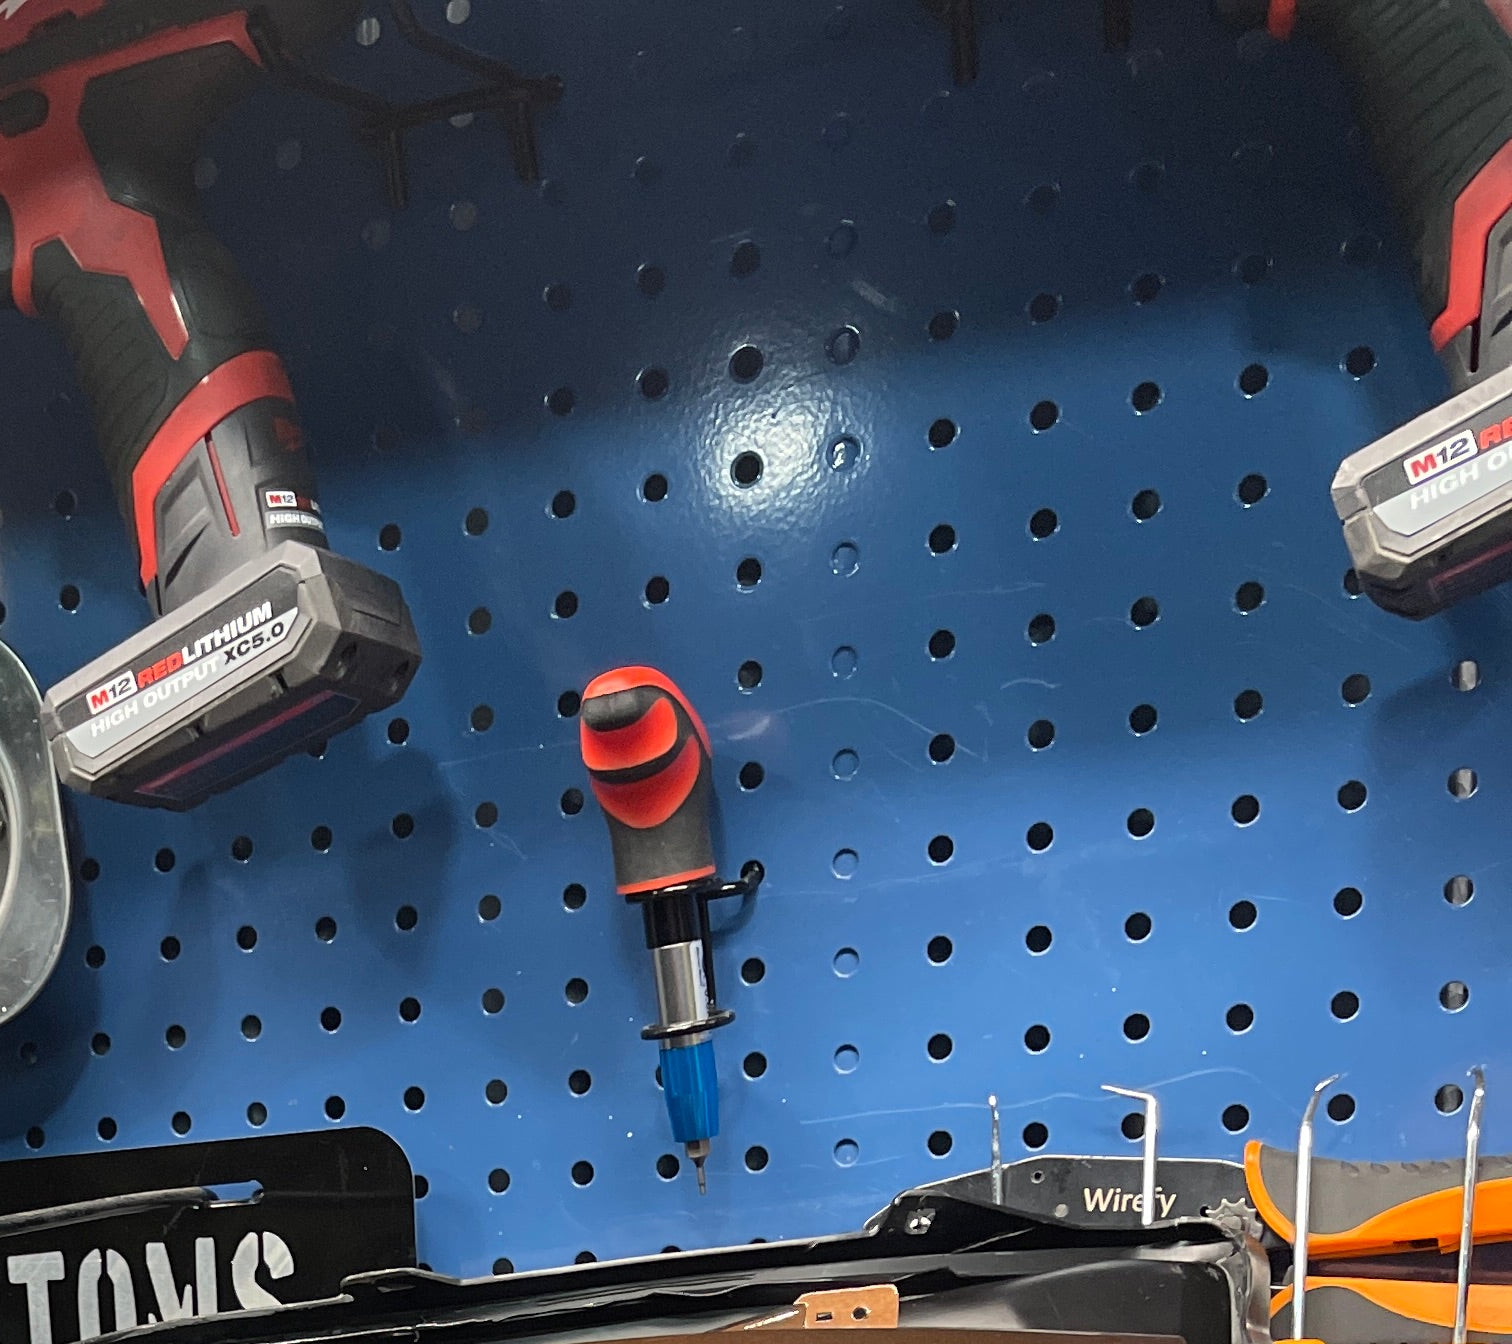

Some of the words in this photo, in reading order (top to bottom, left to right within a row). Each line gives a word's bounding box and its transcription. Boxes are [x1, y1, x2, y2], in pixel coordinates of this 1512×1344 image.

[1409, 436, 1471, 479] M12
[1479, 416, 1512, 450] RE
[268, 494, 295, 505] M12
[1409, 462, 1480, 511] HIGH
[90, 677, 134, 710] M12
[137, 600, 274, 690] REDLITHIUM
[90, 702, 140, 738] HIGH
[143, 657, 220, 709] OUTPUT
[223, 620, 285, 666] XC5.0
